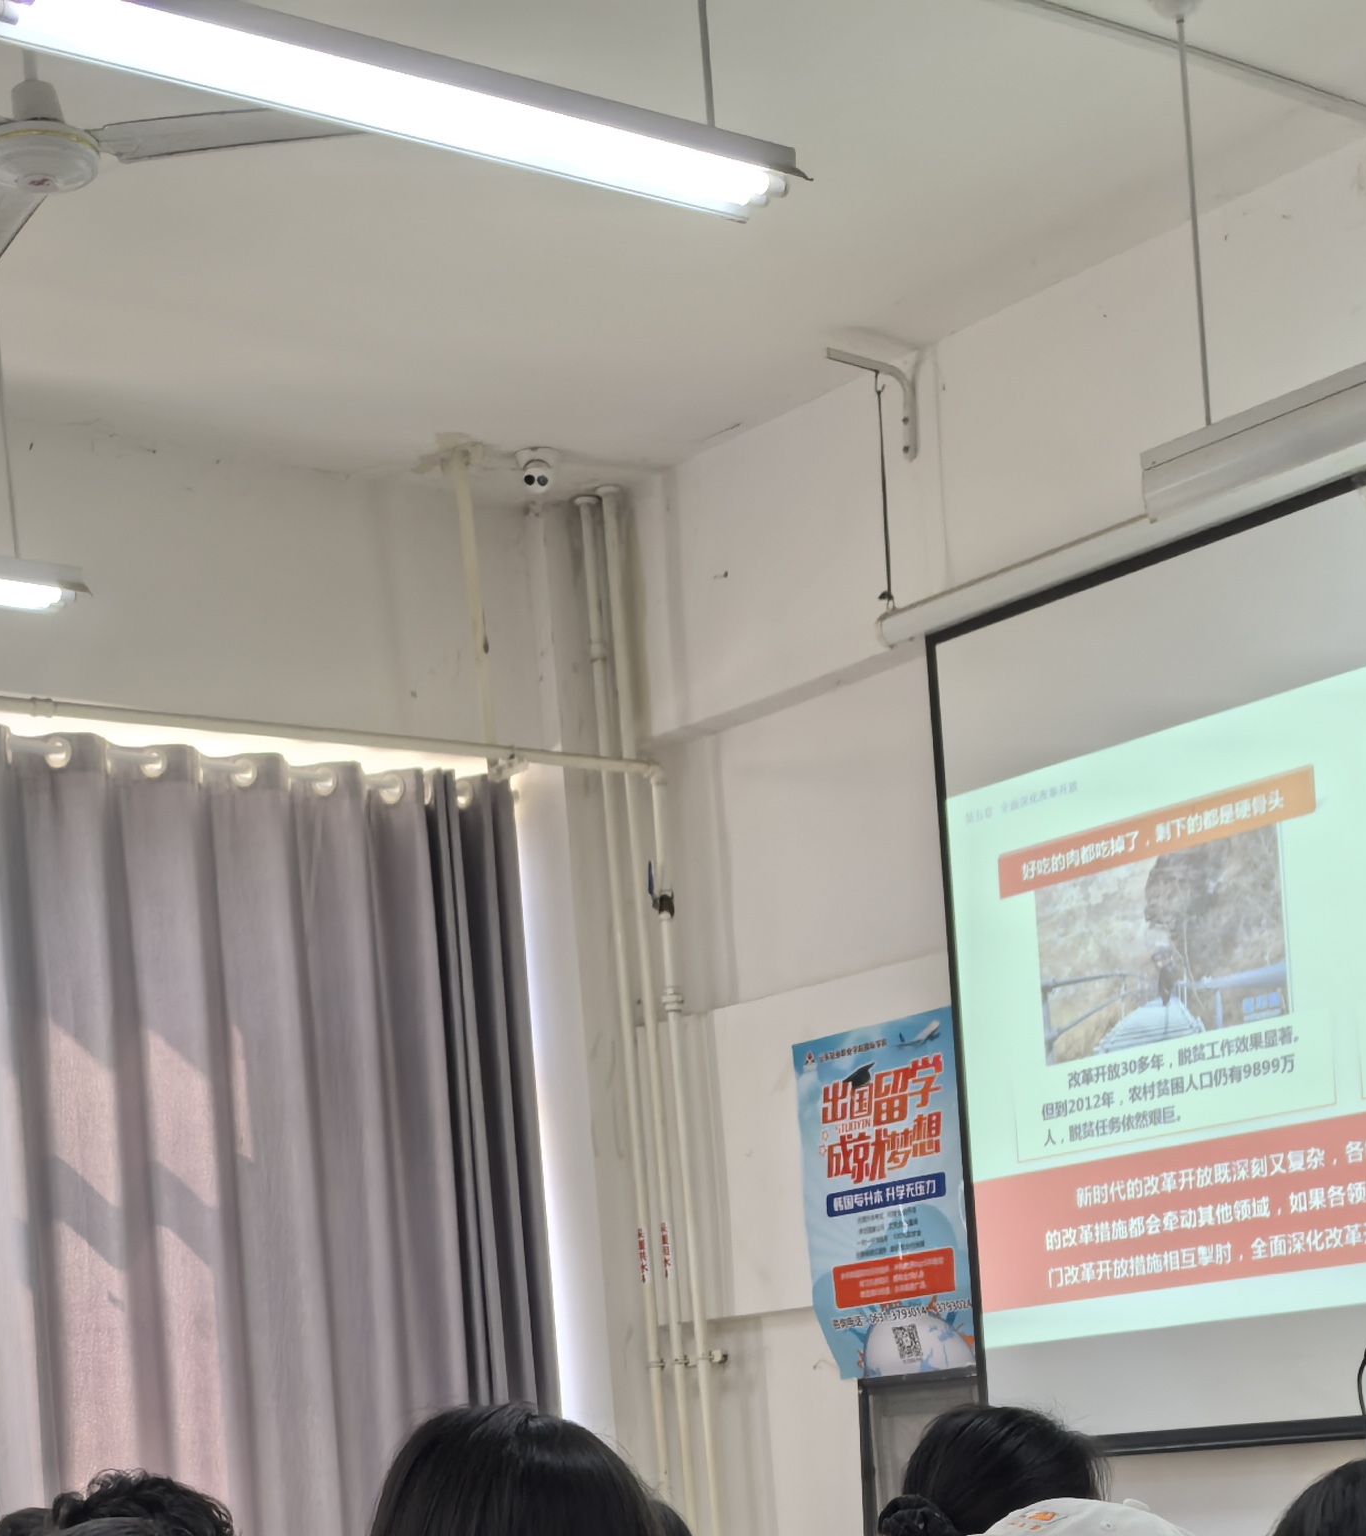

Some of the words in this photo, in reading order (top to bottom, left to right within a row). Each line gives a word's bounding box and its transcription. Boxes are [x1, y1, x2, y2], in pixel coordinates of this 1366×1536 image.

[822, 1054, 943, 1128] 出国留学
[827, 1111, 942, 1185] 成就梦想
[886, 1179, 937, 1202] 升学无压力
